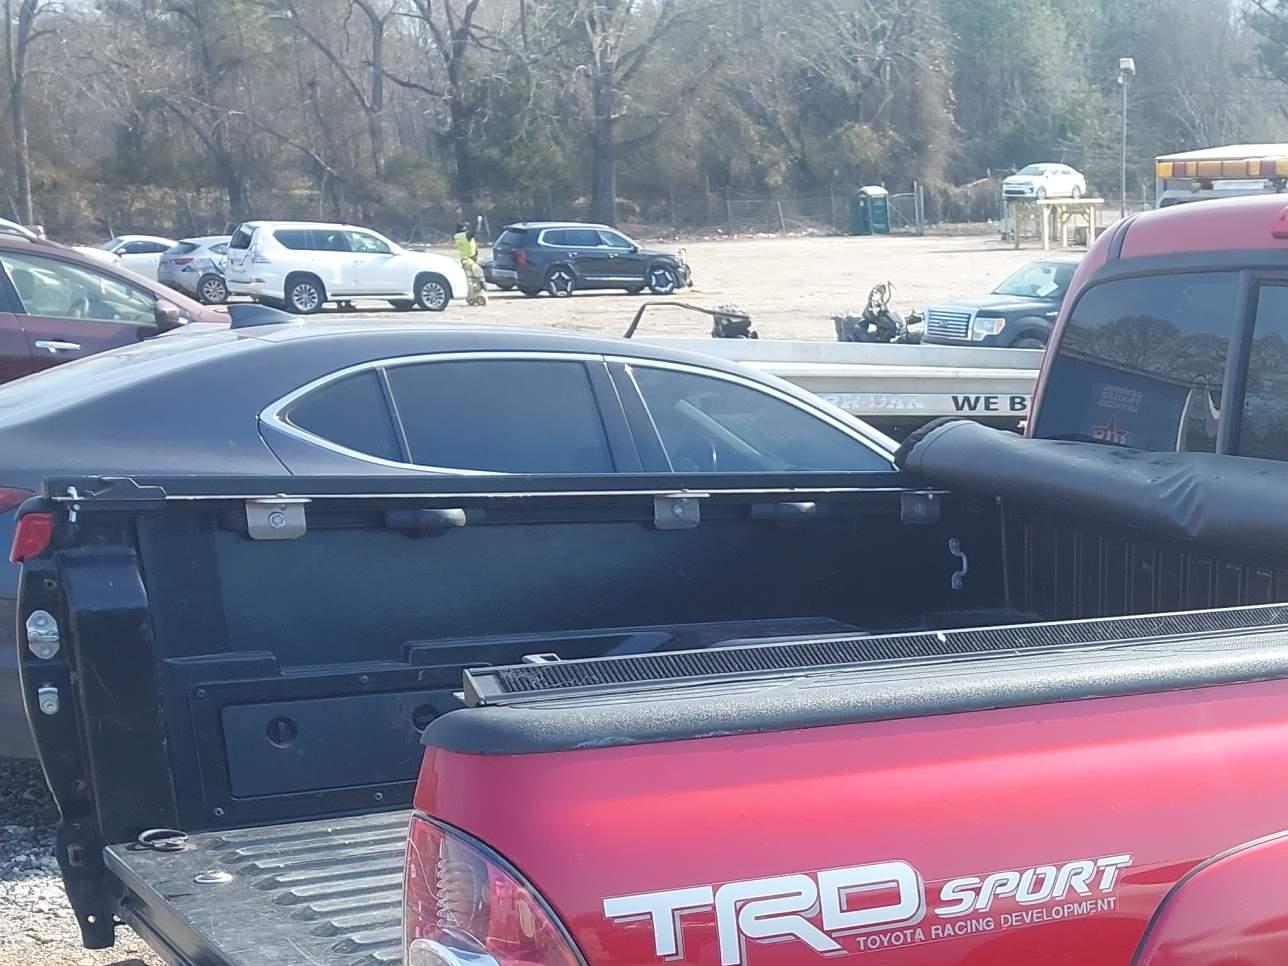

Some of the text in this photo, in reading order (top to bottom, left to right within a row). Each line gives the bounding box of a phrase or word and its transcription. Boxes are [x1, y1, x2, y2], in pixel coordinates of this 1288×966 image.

[951, 395, 1034, 411] WE B
[933, 852, 1134, 919] SPORT
[856, 895, 1118, 952] TOYOTA RACING DEVELOPMENT
